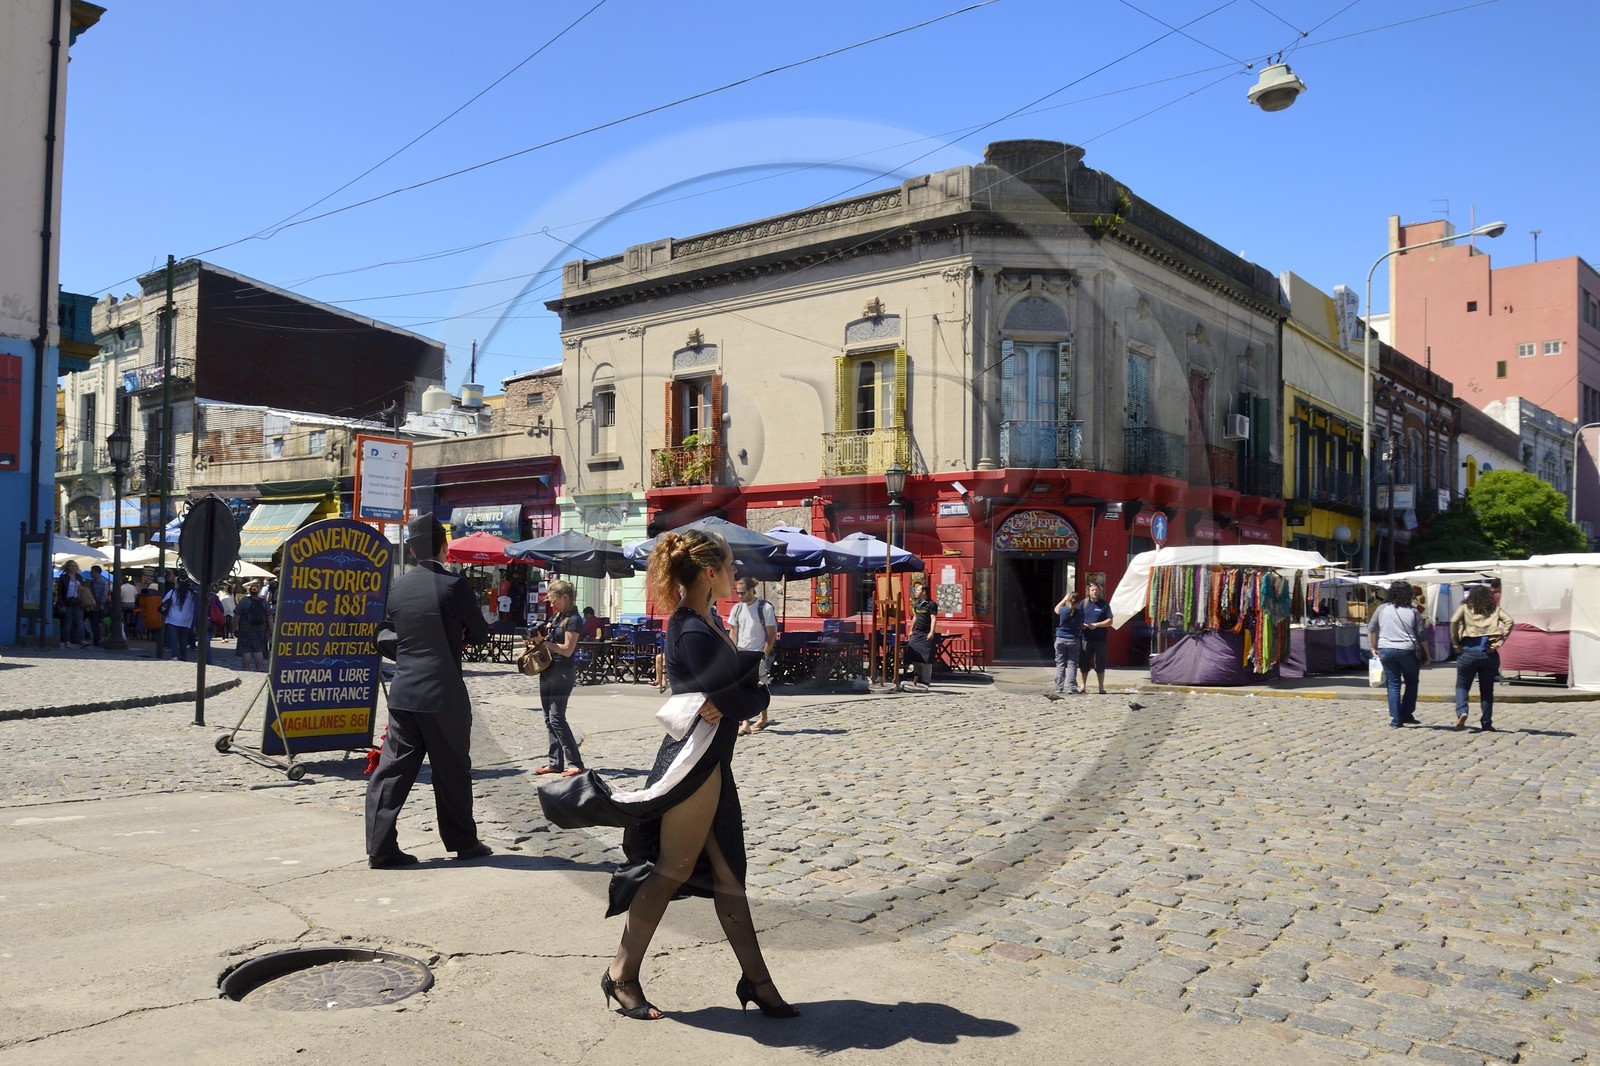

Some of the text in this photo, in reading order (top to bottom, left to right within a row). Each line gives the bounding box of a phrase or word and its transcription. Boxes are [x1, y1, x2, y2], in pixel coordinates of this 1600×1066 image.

[1025, 511, 1063, 530] PERLA
[290, 527, 389, 568] CONVENTILLO
[996, 534, 1079, 551] CAMINITO
[291, 566, 382, 593] HISTORICO
[304, 593, 367, 616] de 1881
[281, 622, 324, 636] CENTRO
[278, 641, 378, 656] DE LOS ARTISTAS
[280, 668, 370, 685] ENTRADA LIBRE
[276, 687, 370, 705] FREE ENTRANCE
[276, 714, 368, 732] MAGALLANES 861
